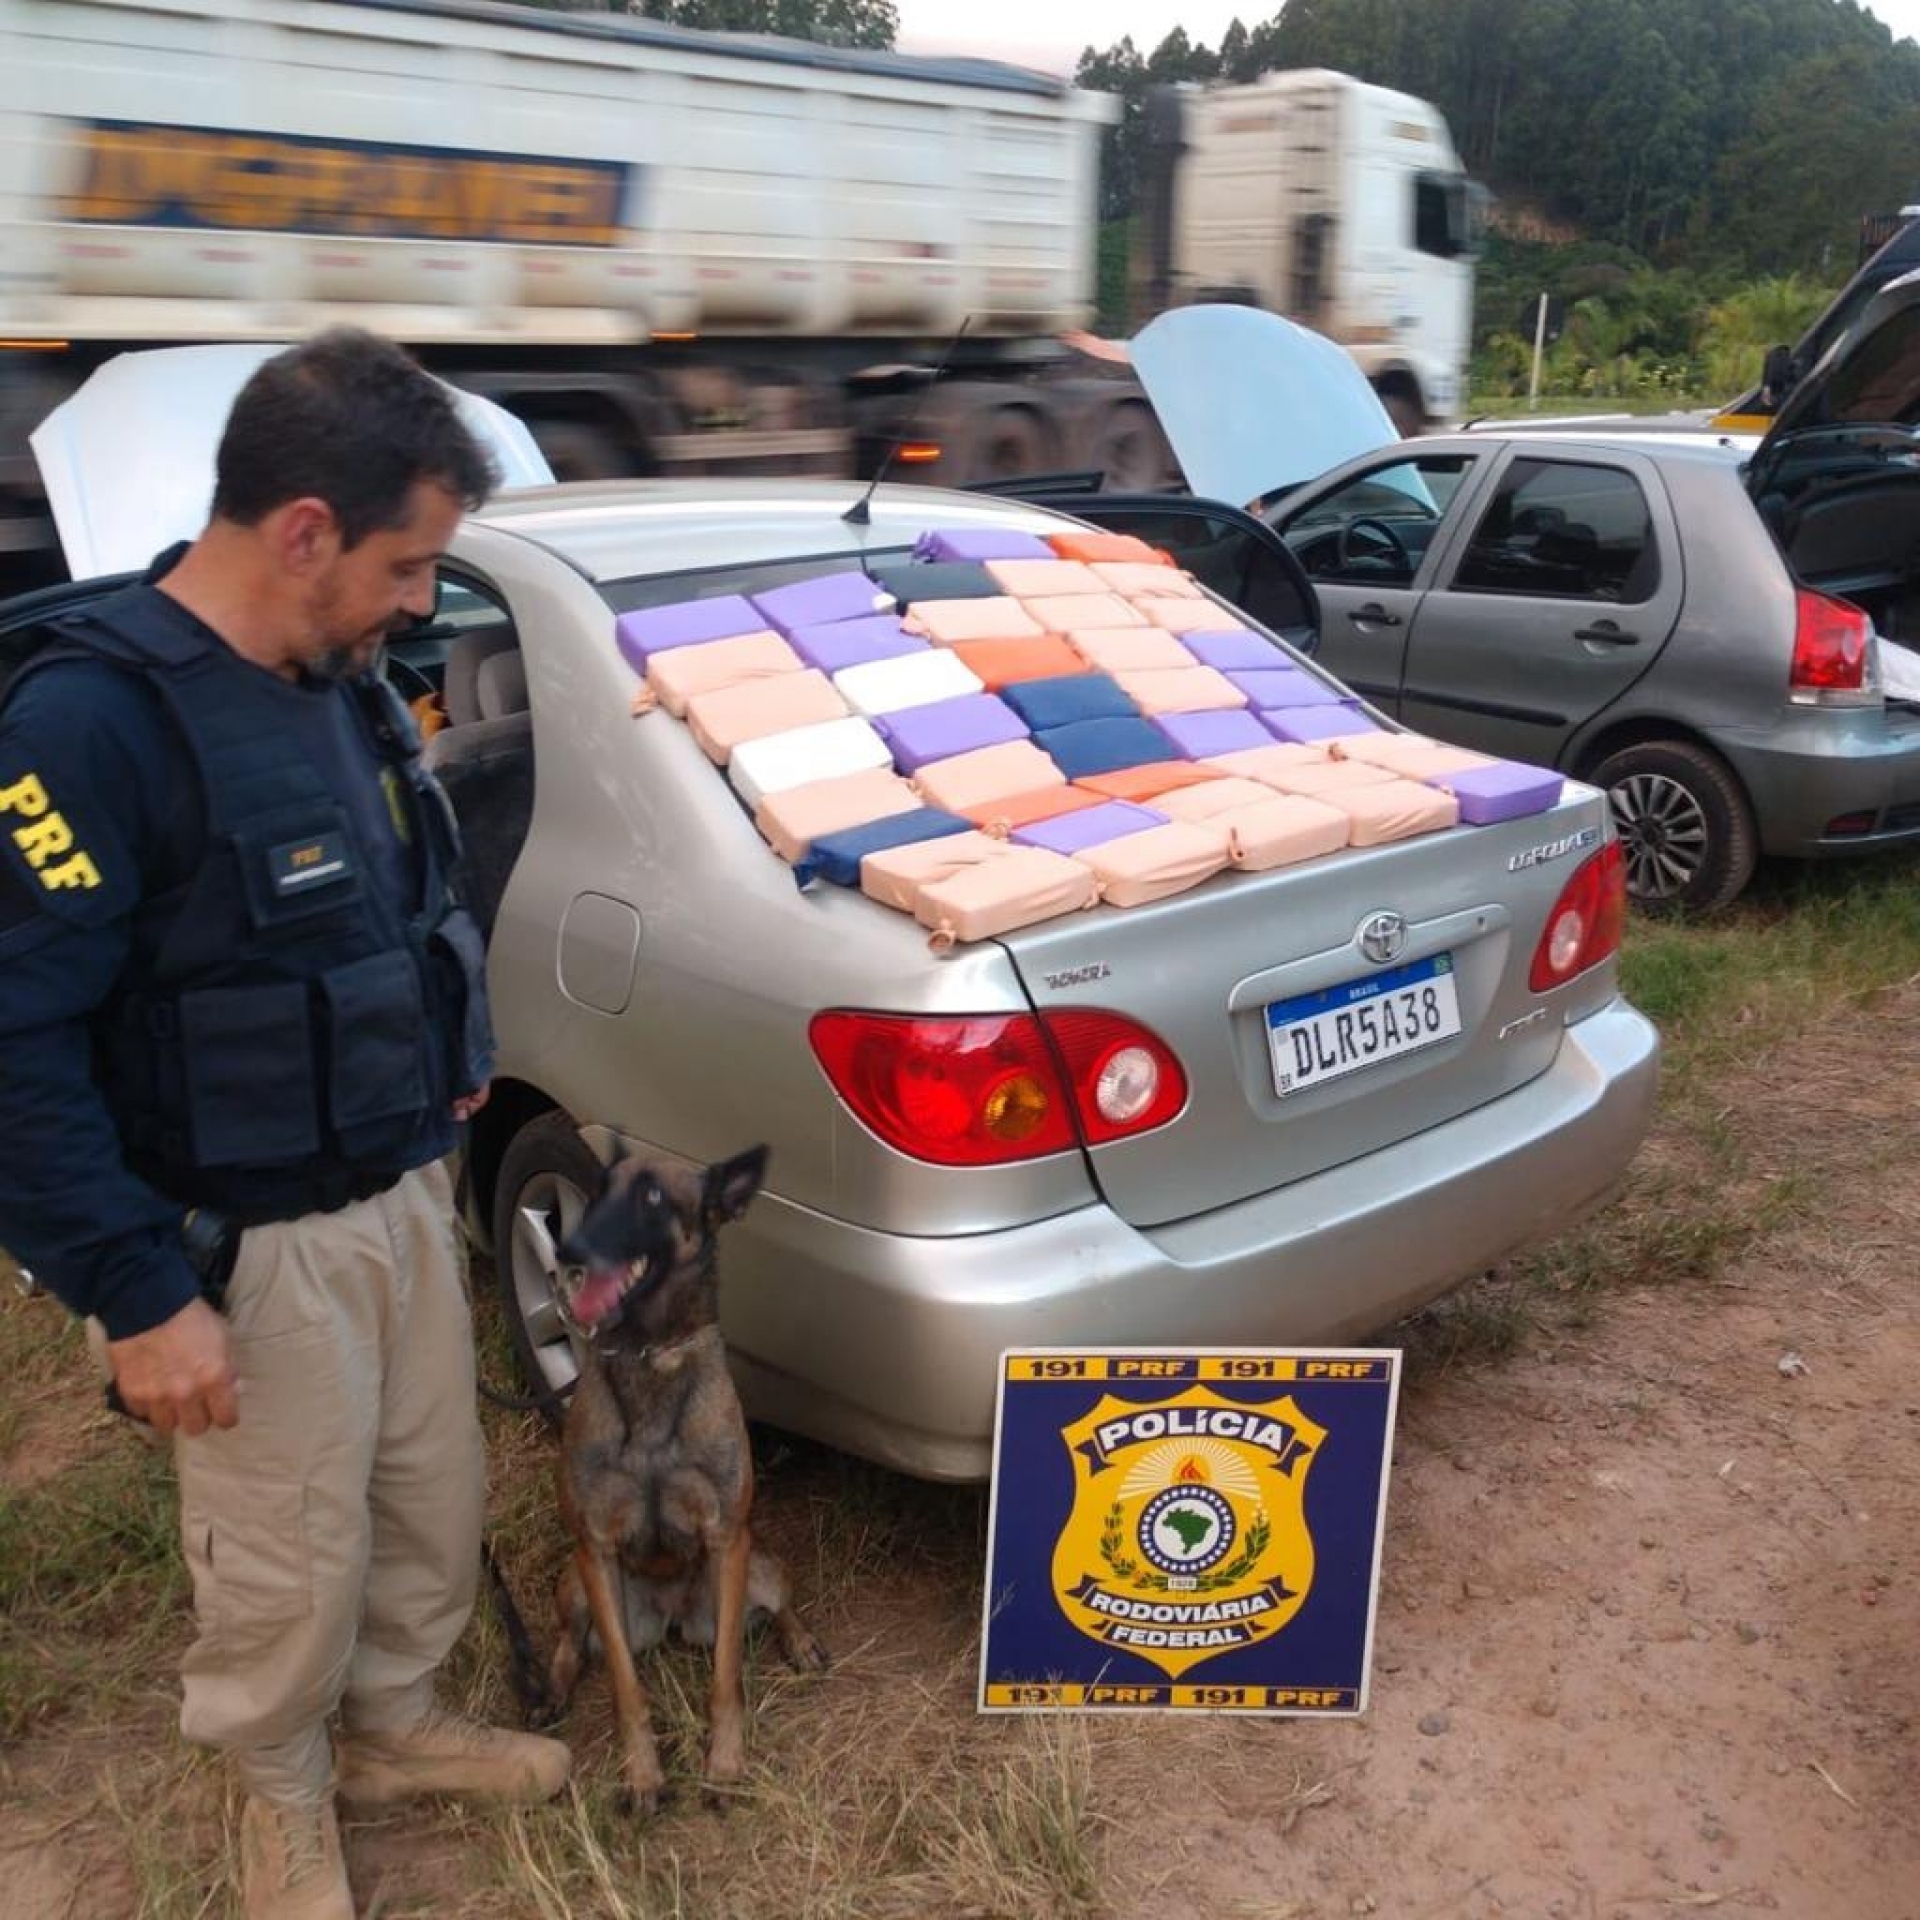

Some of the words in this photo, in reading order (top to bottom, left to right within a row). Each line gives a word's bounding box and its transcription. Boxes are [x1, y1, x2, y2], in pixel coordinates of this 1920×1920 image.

[0, 772, 102, 891] PRF
[1291, 987, 1440, 1077] DLR5A38
[1030, 1360, 1086, 1377] 191
[1117, 1361, 1186, 1376] PRF
[1220, 1360, 1274, 1377] 191
[1305, 1362, 1373, 1378] PRF
[1099, 1409, 1282, 1451] POLÍCIA
[1090, 1592, 1270, 1623] RODOVIÁRIA
[1112, 1625, 1243, 1647] FEDERAL
[1093, 1688, 1158, 1702] PRF
[1193, 1689, 1245, 1704] 191
[1276, 1690, 1341, 1705] PRF
